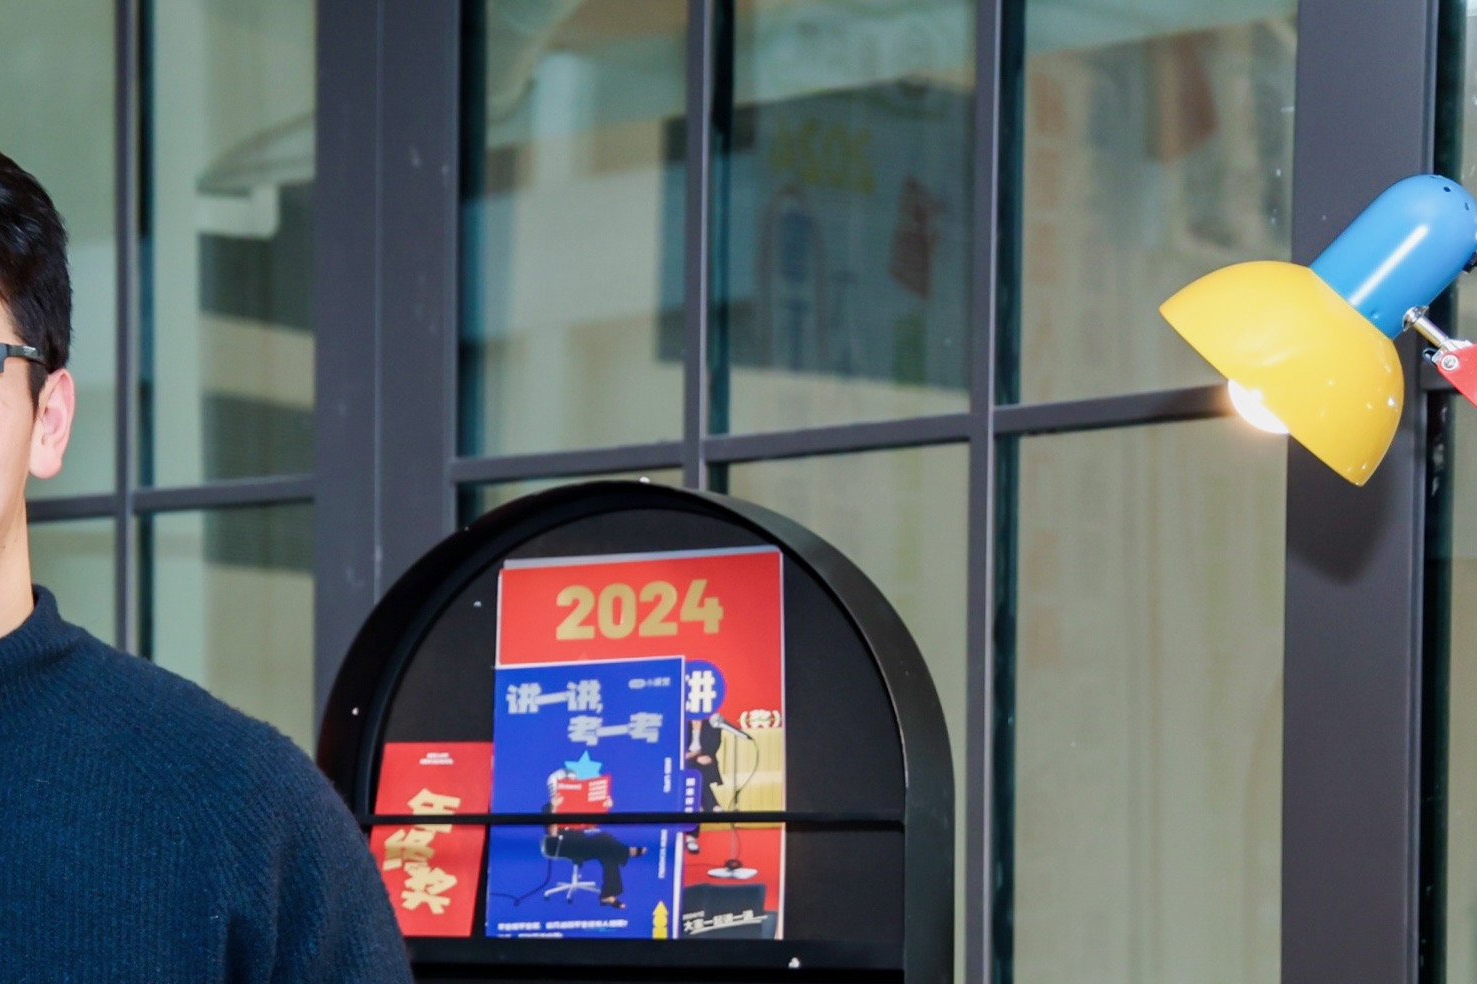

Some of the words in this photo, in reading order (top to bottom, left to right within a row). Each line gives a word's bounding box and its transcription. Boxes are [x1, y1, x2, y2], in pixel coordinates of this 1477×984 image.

[556, 579, 723, 641] 2024
[568, 712, 663, 746] 考一考
